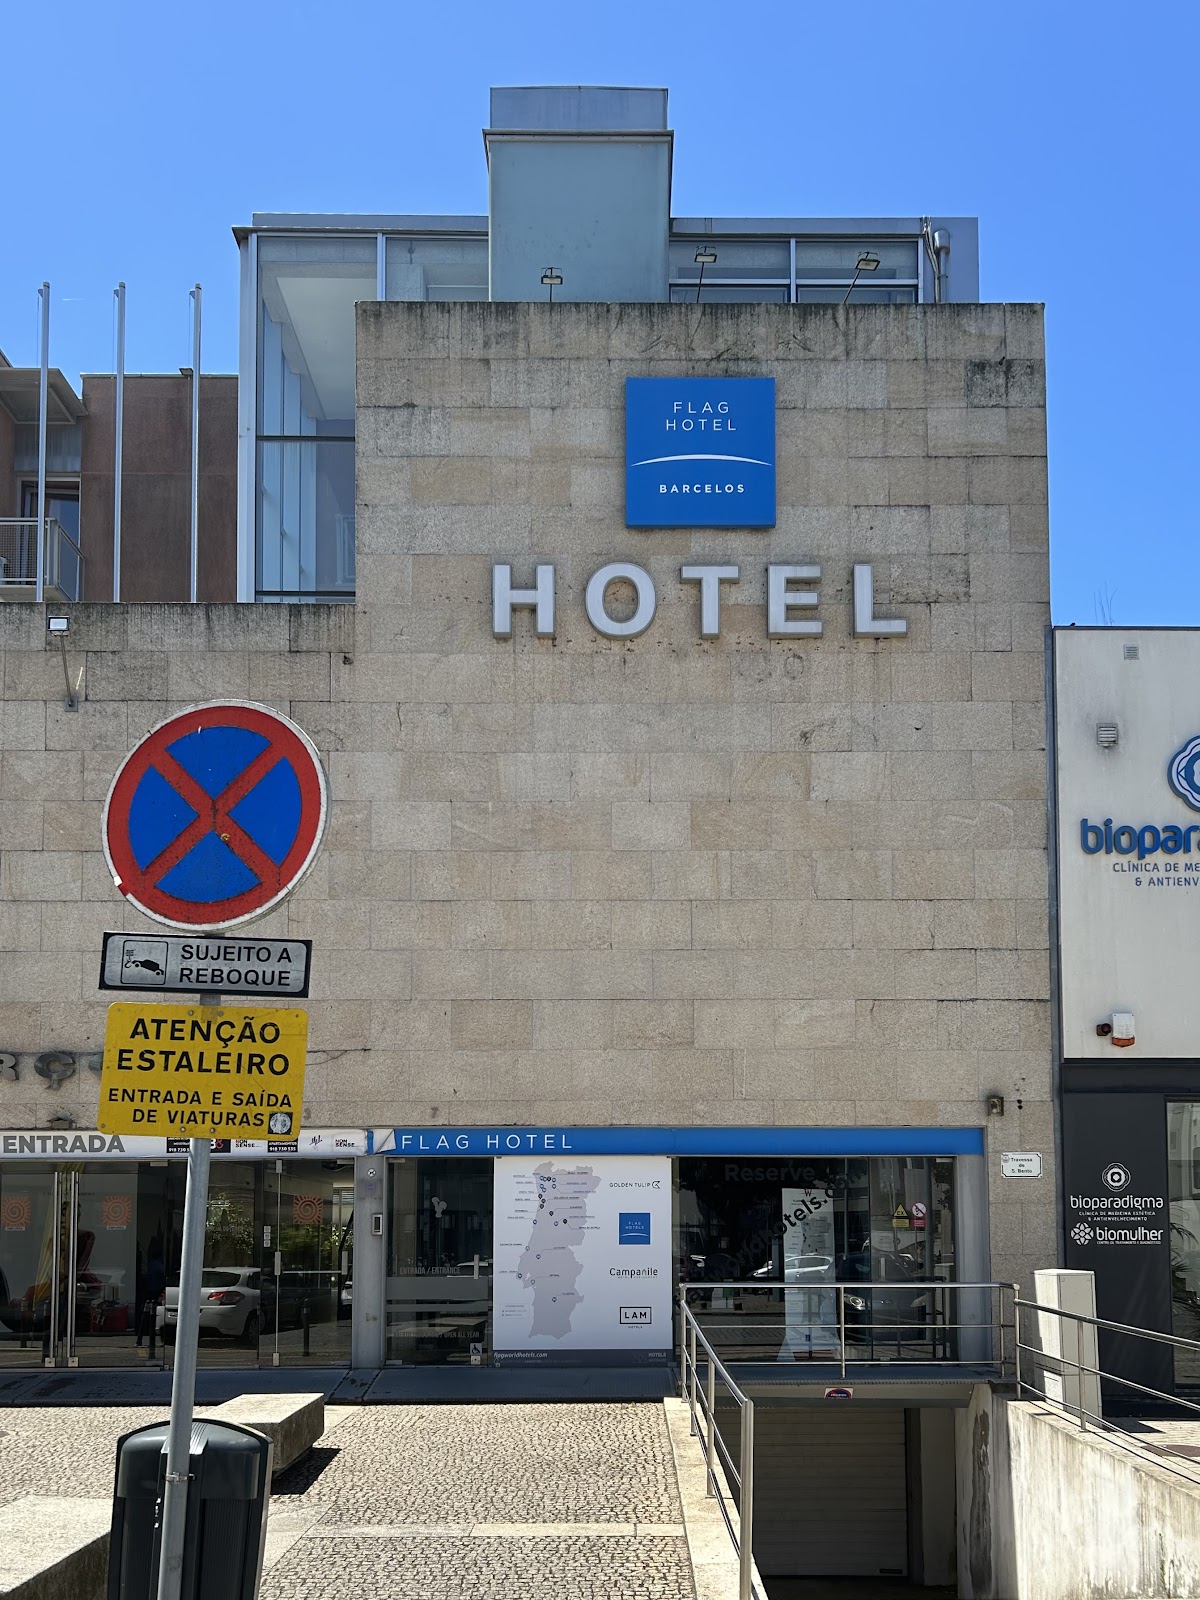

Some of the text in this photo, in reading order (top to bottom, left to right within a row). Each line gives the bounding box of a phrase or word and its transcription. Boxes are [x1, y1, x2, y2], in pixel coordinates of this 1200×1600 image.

[673, 401, 729, 413] FLAG
[666, 419, 736, 431] HOTEL
[660, 484, 745, 494] BARCELOS
[493, 562, 907, 639] HOTEL
[1080, 818, 1200, 860] biopar
[1113, 861, 1159, 872] CLÍNICA
[1165, 863, 1179, 872] DE
[1135, 877, 1142, 886] &
[181, 944, 292, 963] SUJEITO A
[179, 968, 291, 987] REBOQUE
[130, 1016, 280, 1048] ATENÇÃO
[117, 1049, 289, 1075] ESTALEIRO
[108, 1088, 292, 1108] ENTRADA E SAÍDA
[132, 1109, 158, 1123] DE
[167, 1110, 265, 1127] VIATURAS
[3, 1135, 125, 1153] ENTRADA
[402, 1134, 572, 1149] FLAG HOTEL
[725, 1164, 815, 1182] Reserve
[1070, 1195, 1164, 1210] bioparadigma
[1096, 1227, 1163, 1240] biomulher
[399, 1266, 426, 1274] ENTRADA
[431, 1266, 461, 1274] ENTRANCE
[609, 1267, 658, 1278] Campanile
[624, 1311, 647, 1319] LAM
